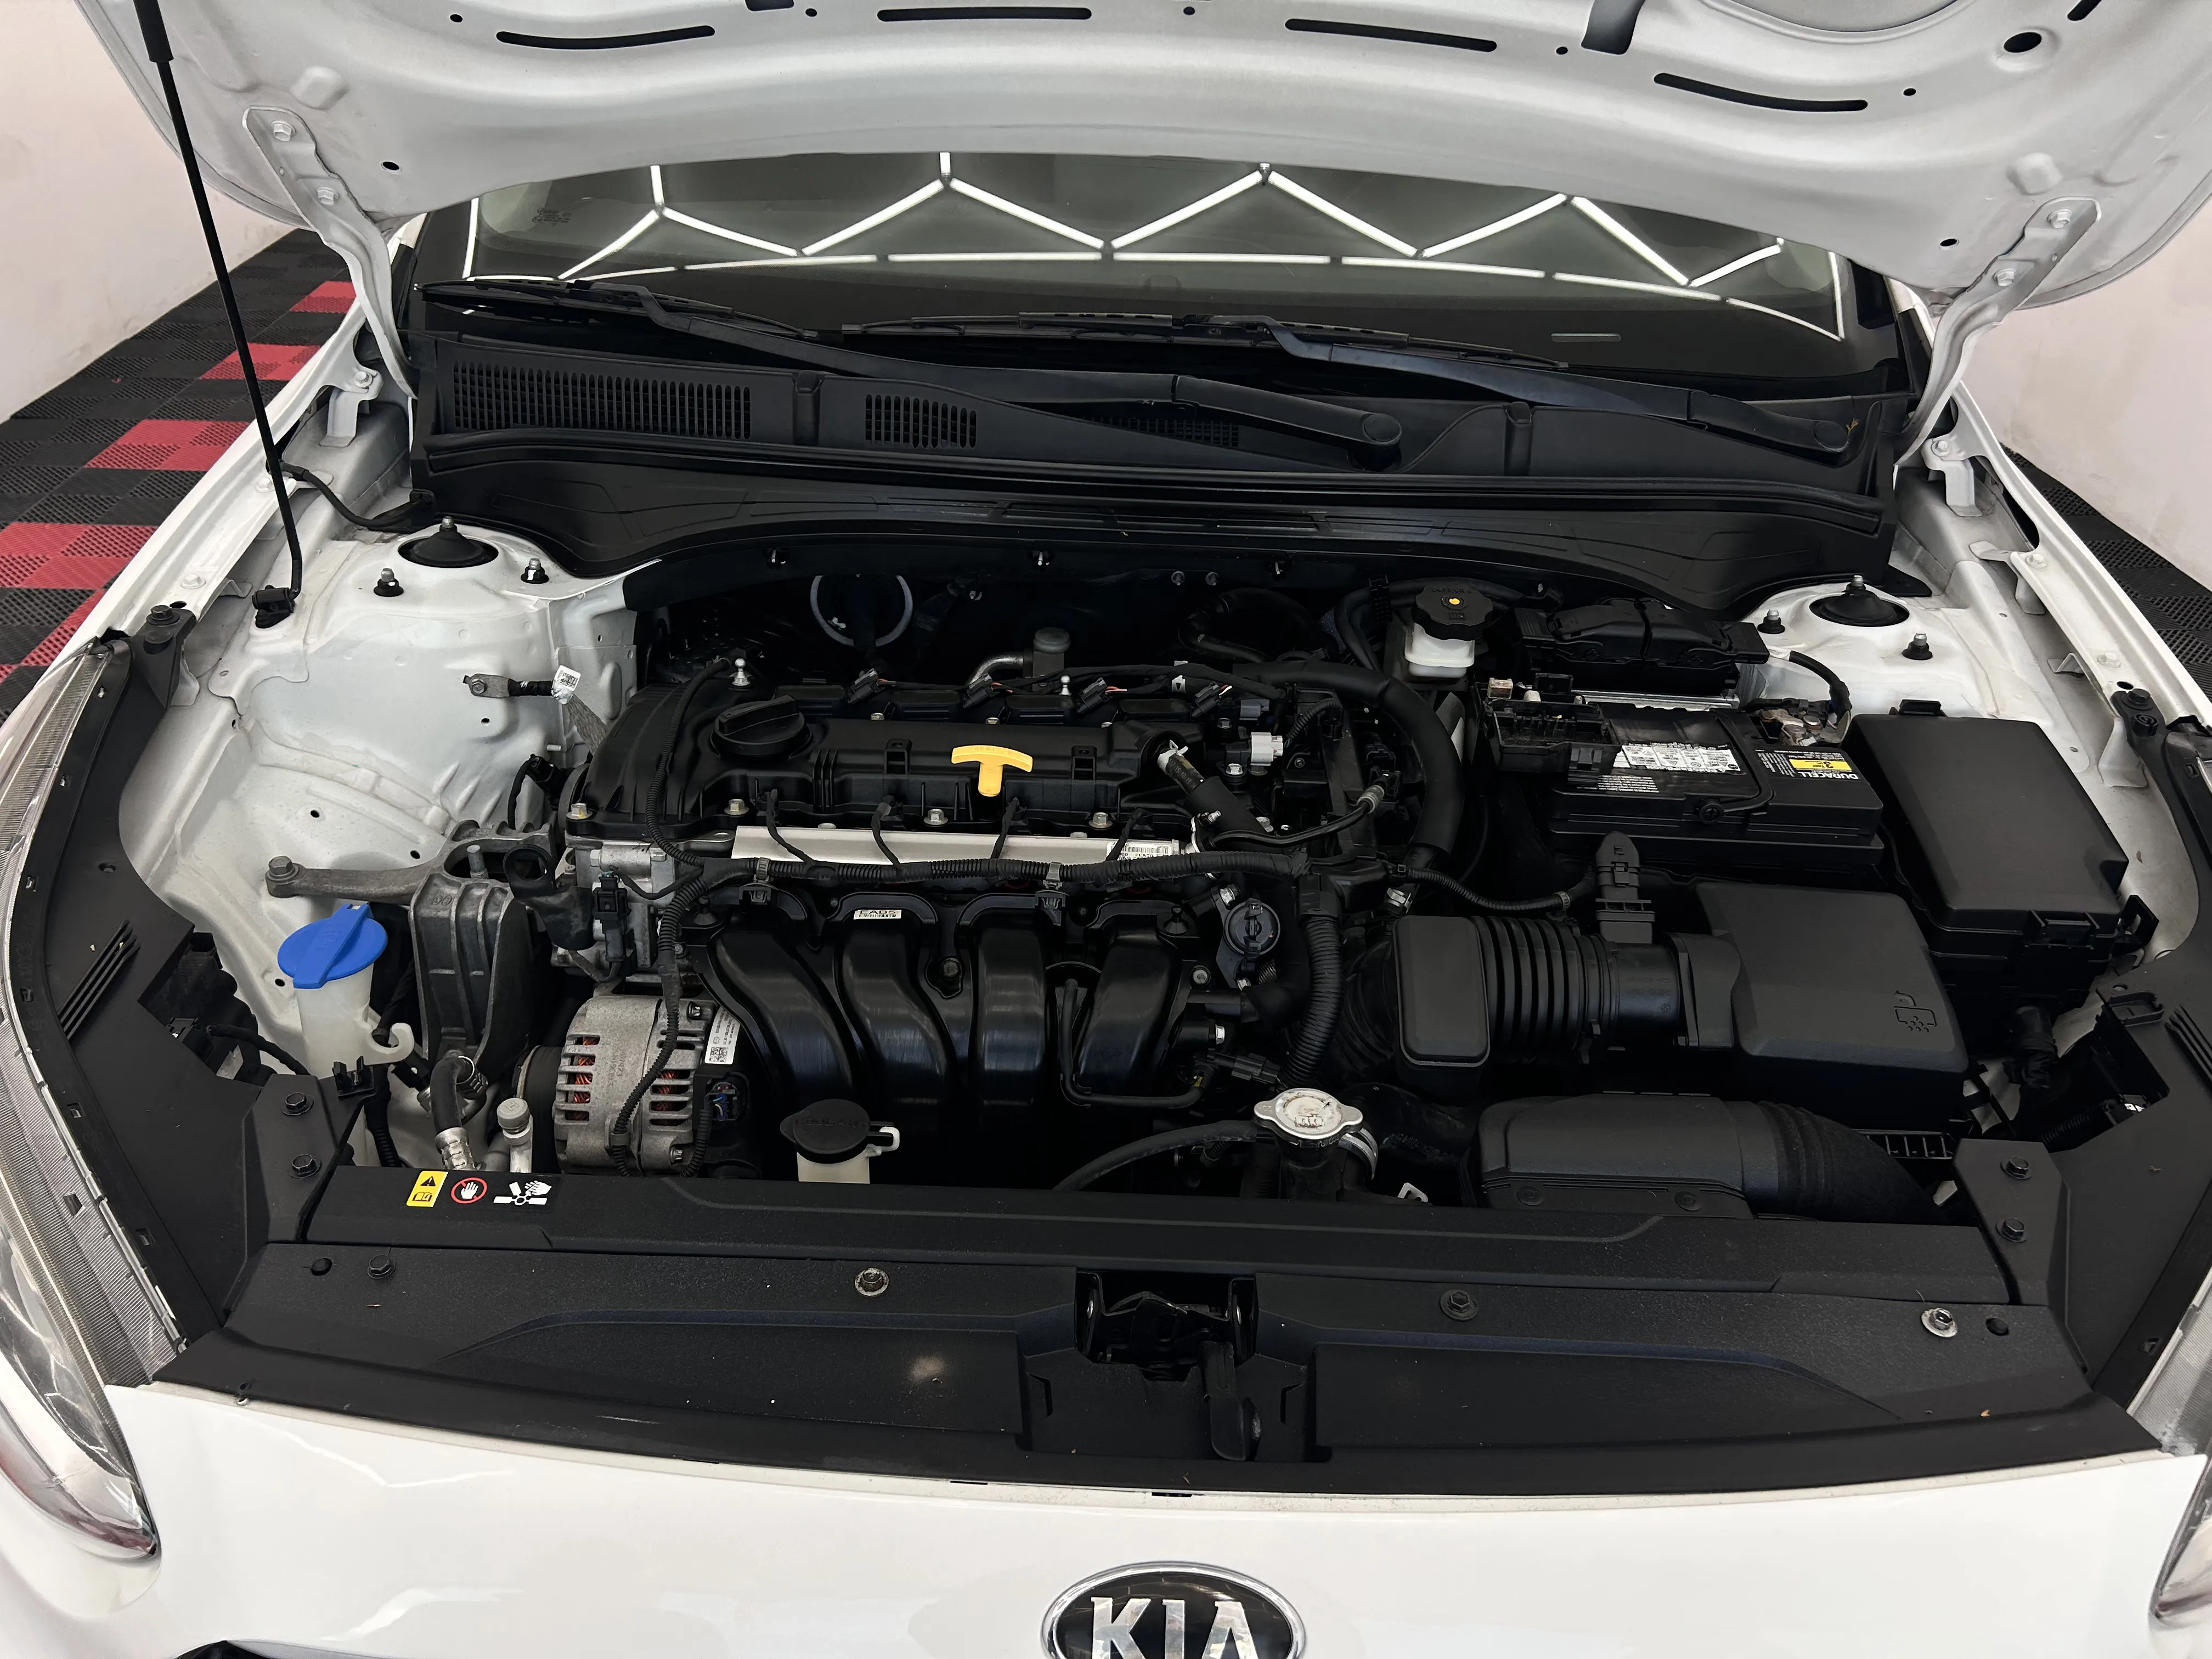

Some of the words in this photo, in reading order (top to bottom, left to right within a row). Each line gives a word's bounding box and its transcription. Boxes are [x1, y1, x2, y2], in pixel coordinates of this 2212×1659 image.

[1798, 771, 1859, 780] DURACELL
[796, 1117, 868, 1131] COOLANT
[1091, 1596, 1260, 1659] KIA
